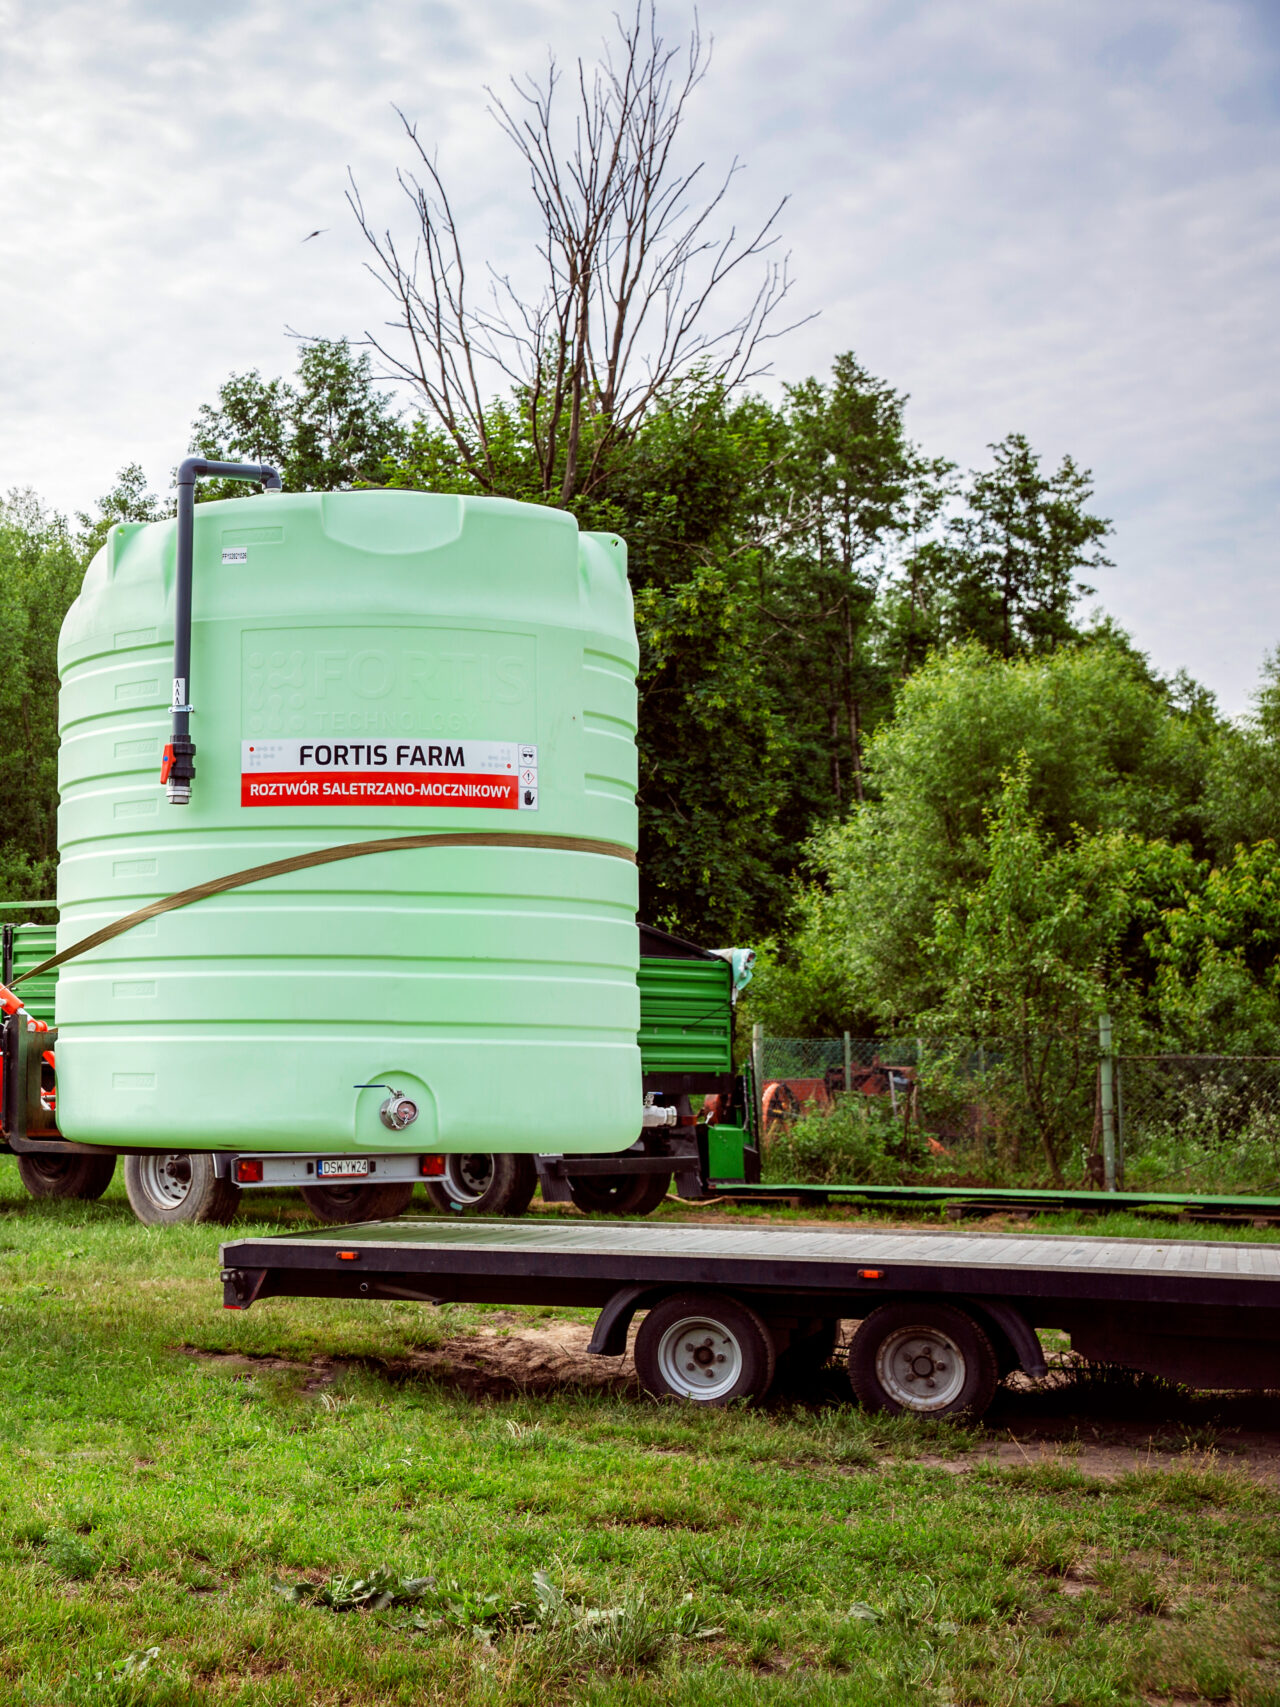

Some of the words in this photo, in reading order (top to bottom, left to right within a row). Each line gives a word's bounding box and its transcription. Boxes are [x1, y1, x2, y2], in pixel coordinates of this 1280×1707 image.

[312, 649, 529, 704] FORTIS
[312, 711, 477, 732] TECHNOLOGY
[299, 745, 388, 766] FORTIS
[396, 745, 465, 767] FARM
[250, 780, 319, 796] ROZTWÓR
[322, 782, 511, 799] SALETRZANO-MOCZNIKOWY
[323, 1161, 343, 1174] DSW
[345, 1160, 367, 1173] YW24
